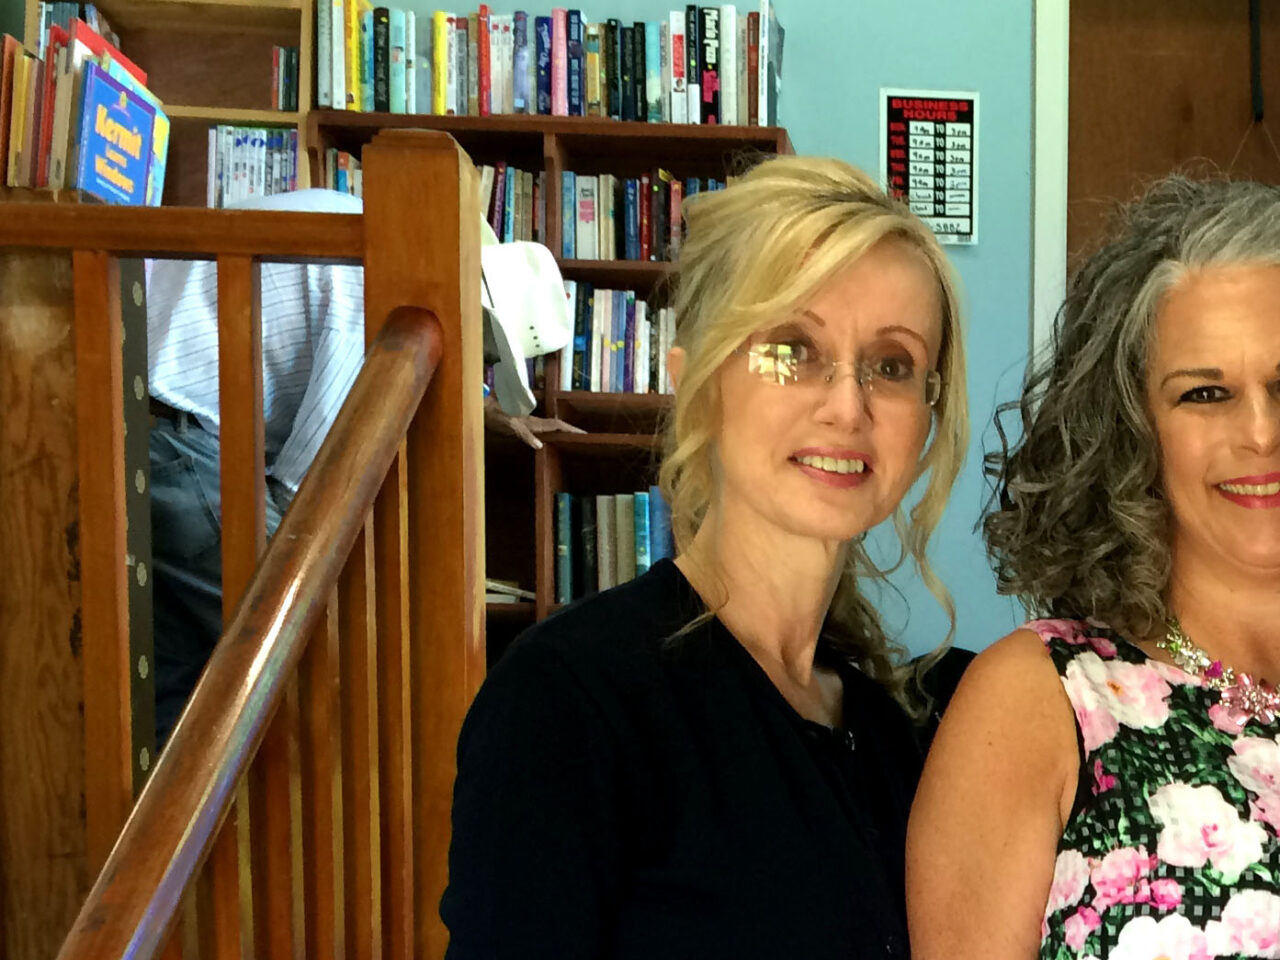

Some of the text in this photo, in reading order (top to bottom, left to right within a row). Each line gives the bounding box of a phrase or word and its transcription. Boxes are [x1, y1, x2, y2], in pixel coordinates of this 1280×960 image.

[892, 98, 969, 112] BUSINESS
[903, 109, 958, 121] HOURS
[95, 104, 142, 160] Kermit
[936, 124, 945, 134] TO
[936, 137, 945, 147] TO
[935, 151, 945, 161] TO
[935, 164, 945, 174] TO
[935, 177, 945, 187] TO
[935, 191, 945, 201] TO
[935, 204, 945, 214] TO
